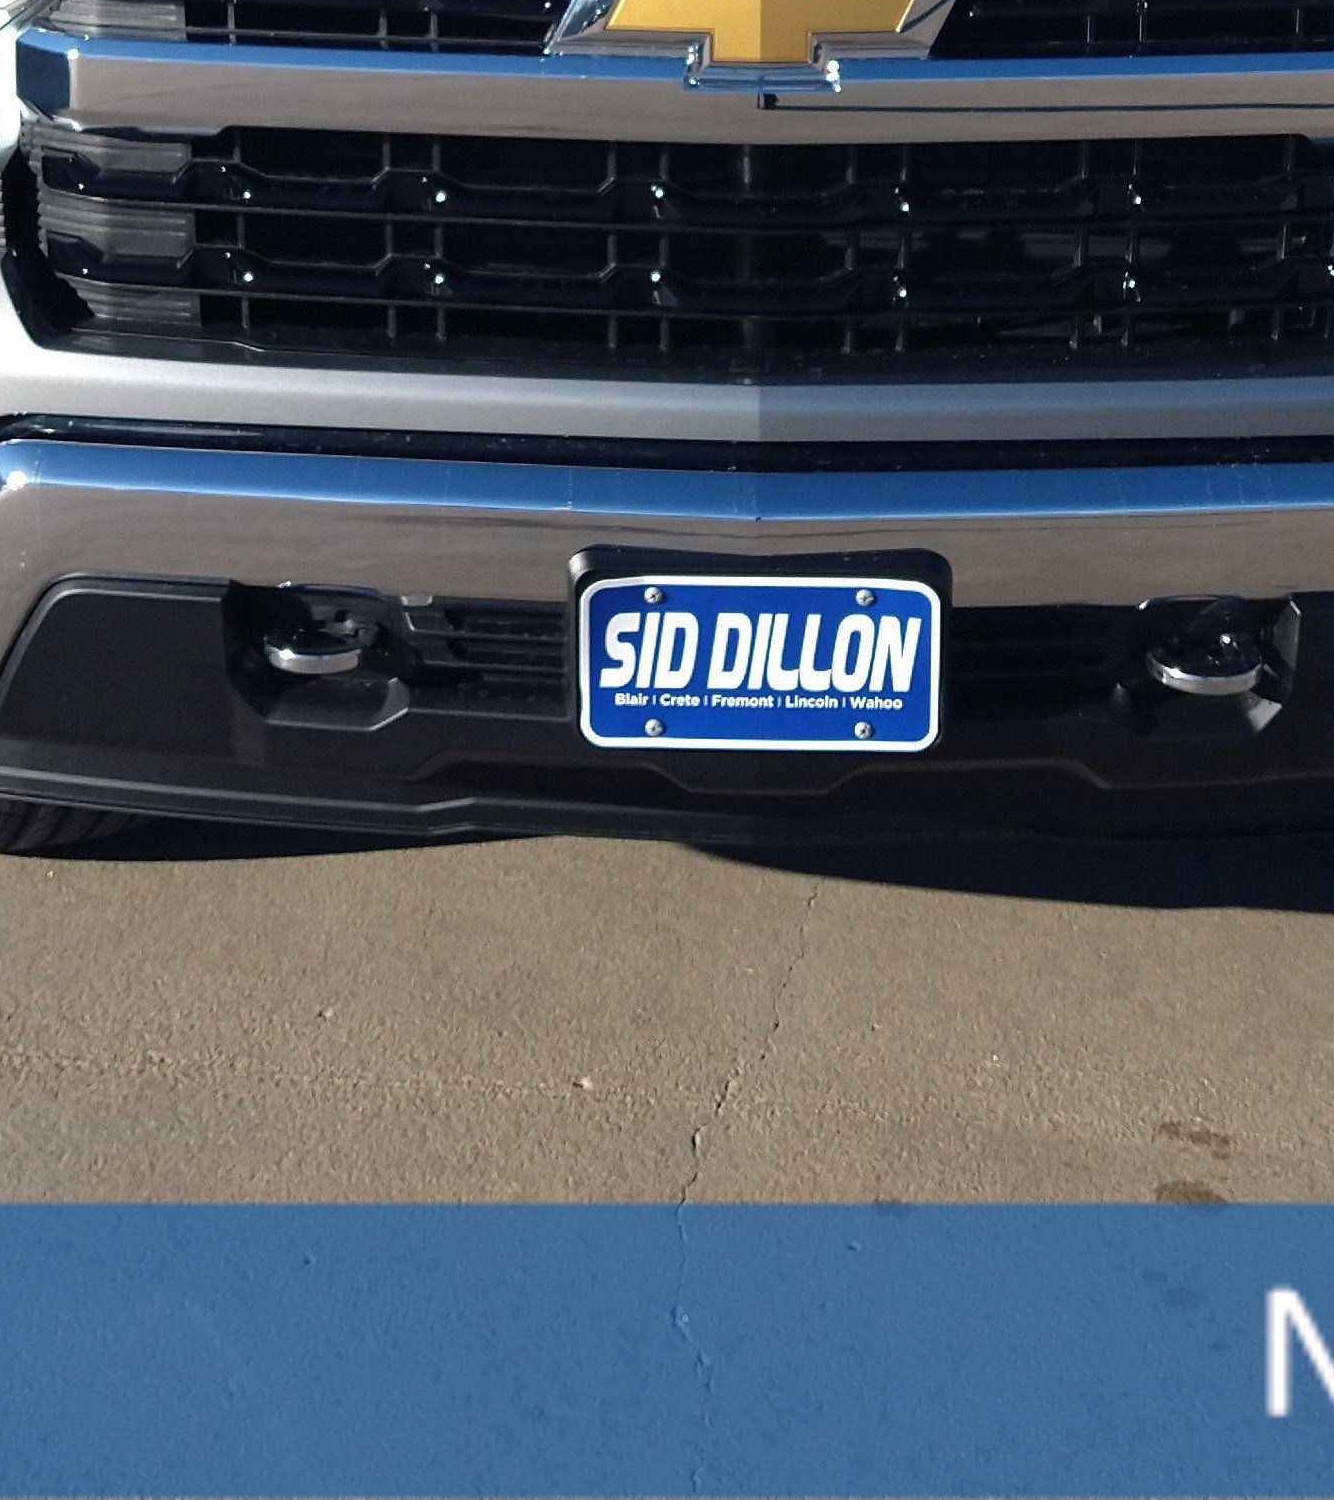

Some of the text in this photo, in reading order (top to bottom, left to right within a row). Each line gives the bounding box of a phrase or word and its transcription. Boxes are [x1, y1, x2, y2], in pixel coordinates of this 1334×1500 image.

[599, 611, 922, 693] SID DILLON
[614, 692, 903, 710] Blair Crete Fremont Lincoln Wahoo
